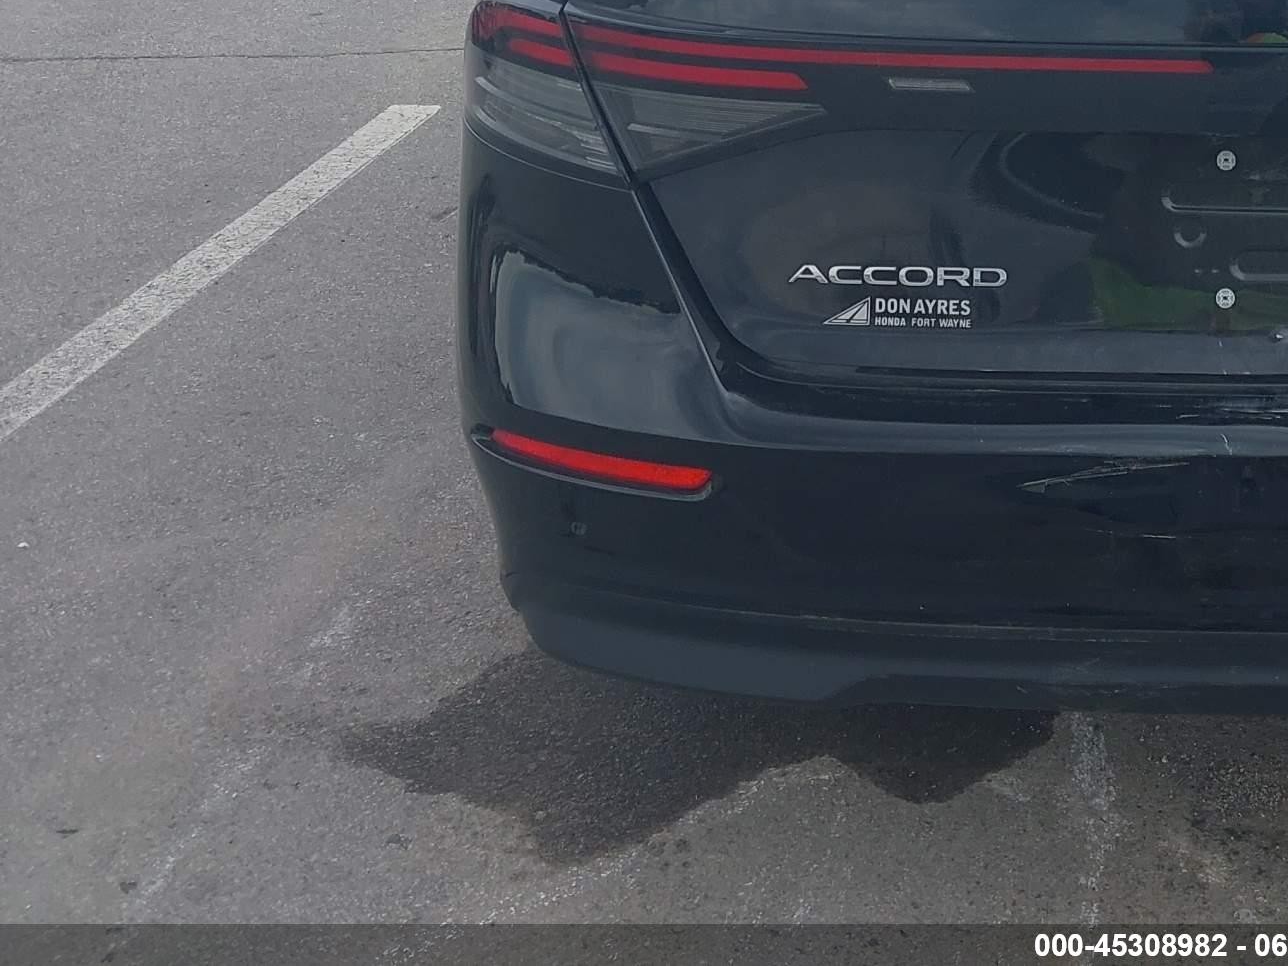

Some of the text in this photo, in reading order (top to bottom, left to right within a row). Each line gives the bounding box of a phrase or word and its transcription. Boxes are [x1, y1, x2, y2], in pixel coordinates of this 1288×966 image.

[788, 264, 1008, 287] ACCORD
[874, 297, 971, 316] DON AYRES
[874, 316, 972, 329] HONDA FORT WAYNE
